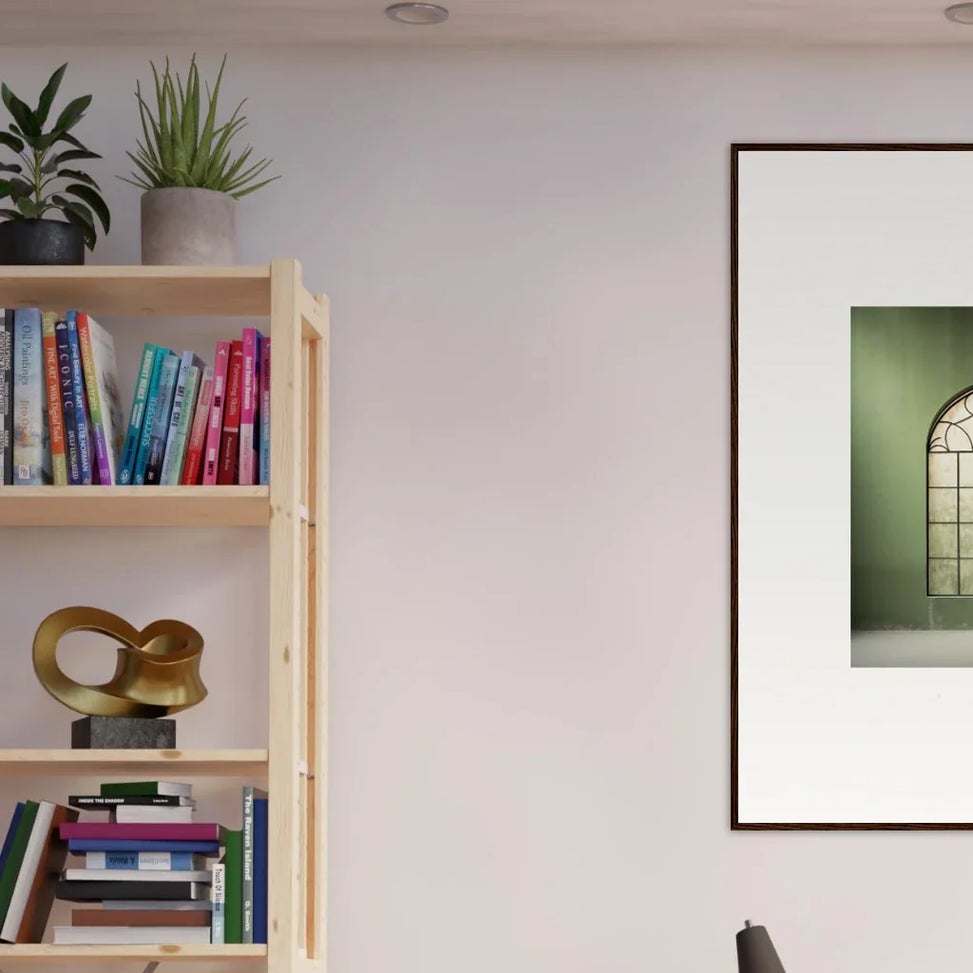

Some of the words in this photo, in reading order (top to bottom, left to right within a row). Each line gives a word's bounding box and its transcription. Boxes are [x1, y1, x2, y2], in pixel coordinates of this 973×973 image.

[23, 324, 32, 340] Oil
[19, 341, 31, 386] Paintings
[47, 346, 55, 364] FINE
[48, 364, 56, 380] ART
[59, 343, 73, 409] ICONIC
[80, 326, 93, 374] Watercolor
[87, 374, 99, 411] Portraits
[230, 362, 241, 397] Parenting
[50, 384, 58, 401] With
[75, 393, 83, 409] ART
[49, 401, 60, 425] Digital
[229, 397, 238, 416] Skills
[53, 425, 62, 443] Tools
[244, 849, 252, 880] Island
[215, 884, 222, 892] Of
